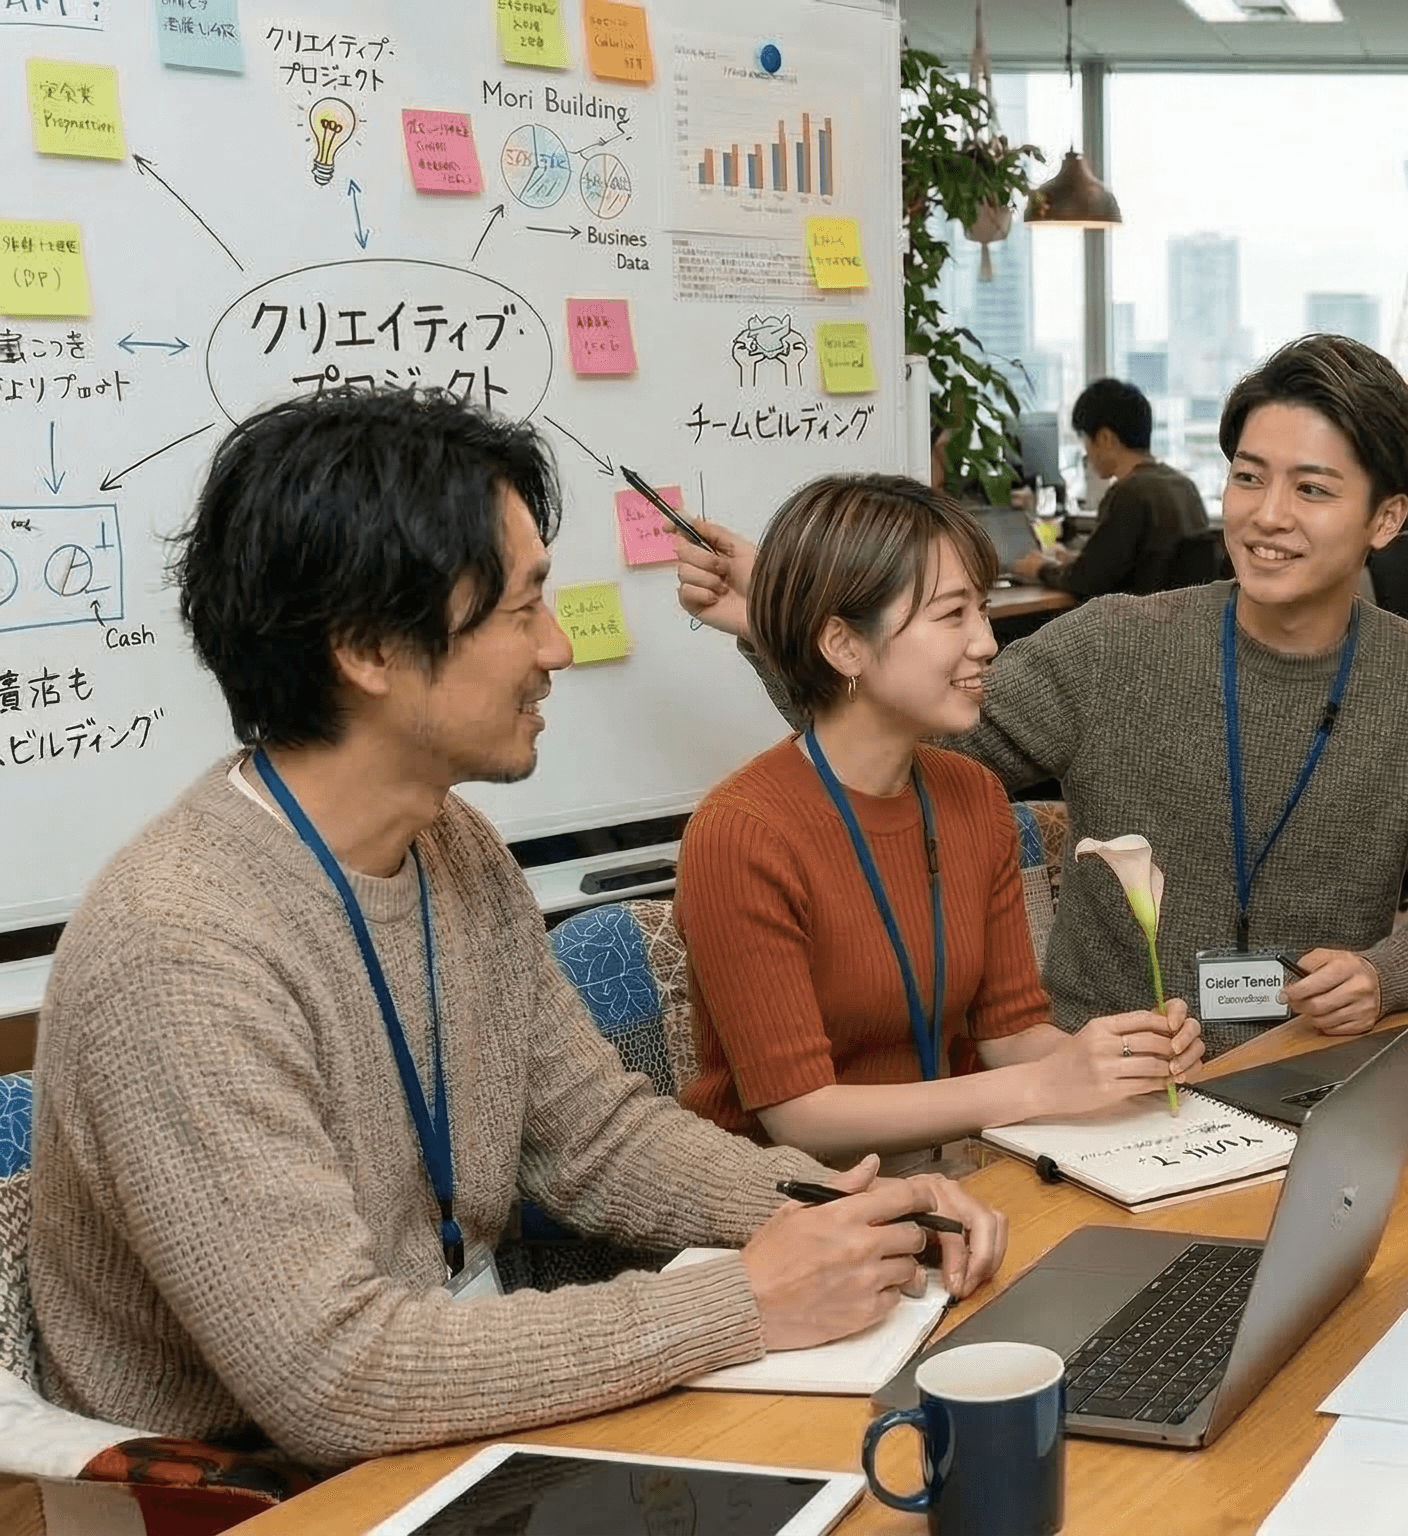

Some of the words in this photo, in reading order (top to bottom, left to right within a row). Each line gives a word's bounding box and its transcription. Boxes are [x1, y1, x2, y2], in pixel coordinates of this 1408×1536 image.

[279, 61, 384, 92] プロジェクト
[482, 80, 533, 110] Mori
[545, 86, 629, 124] Building
[587, 225, 647, 247] Busines
[617, 252, 650, 271] Data
[685, 402, 875, 445] チームビルディング
[106, 623, 155, 649] Cash
[0, 706, 164, 767] ビルディング
[1242, 974, 1281, 988] Teneh
